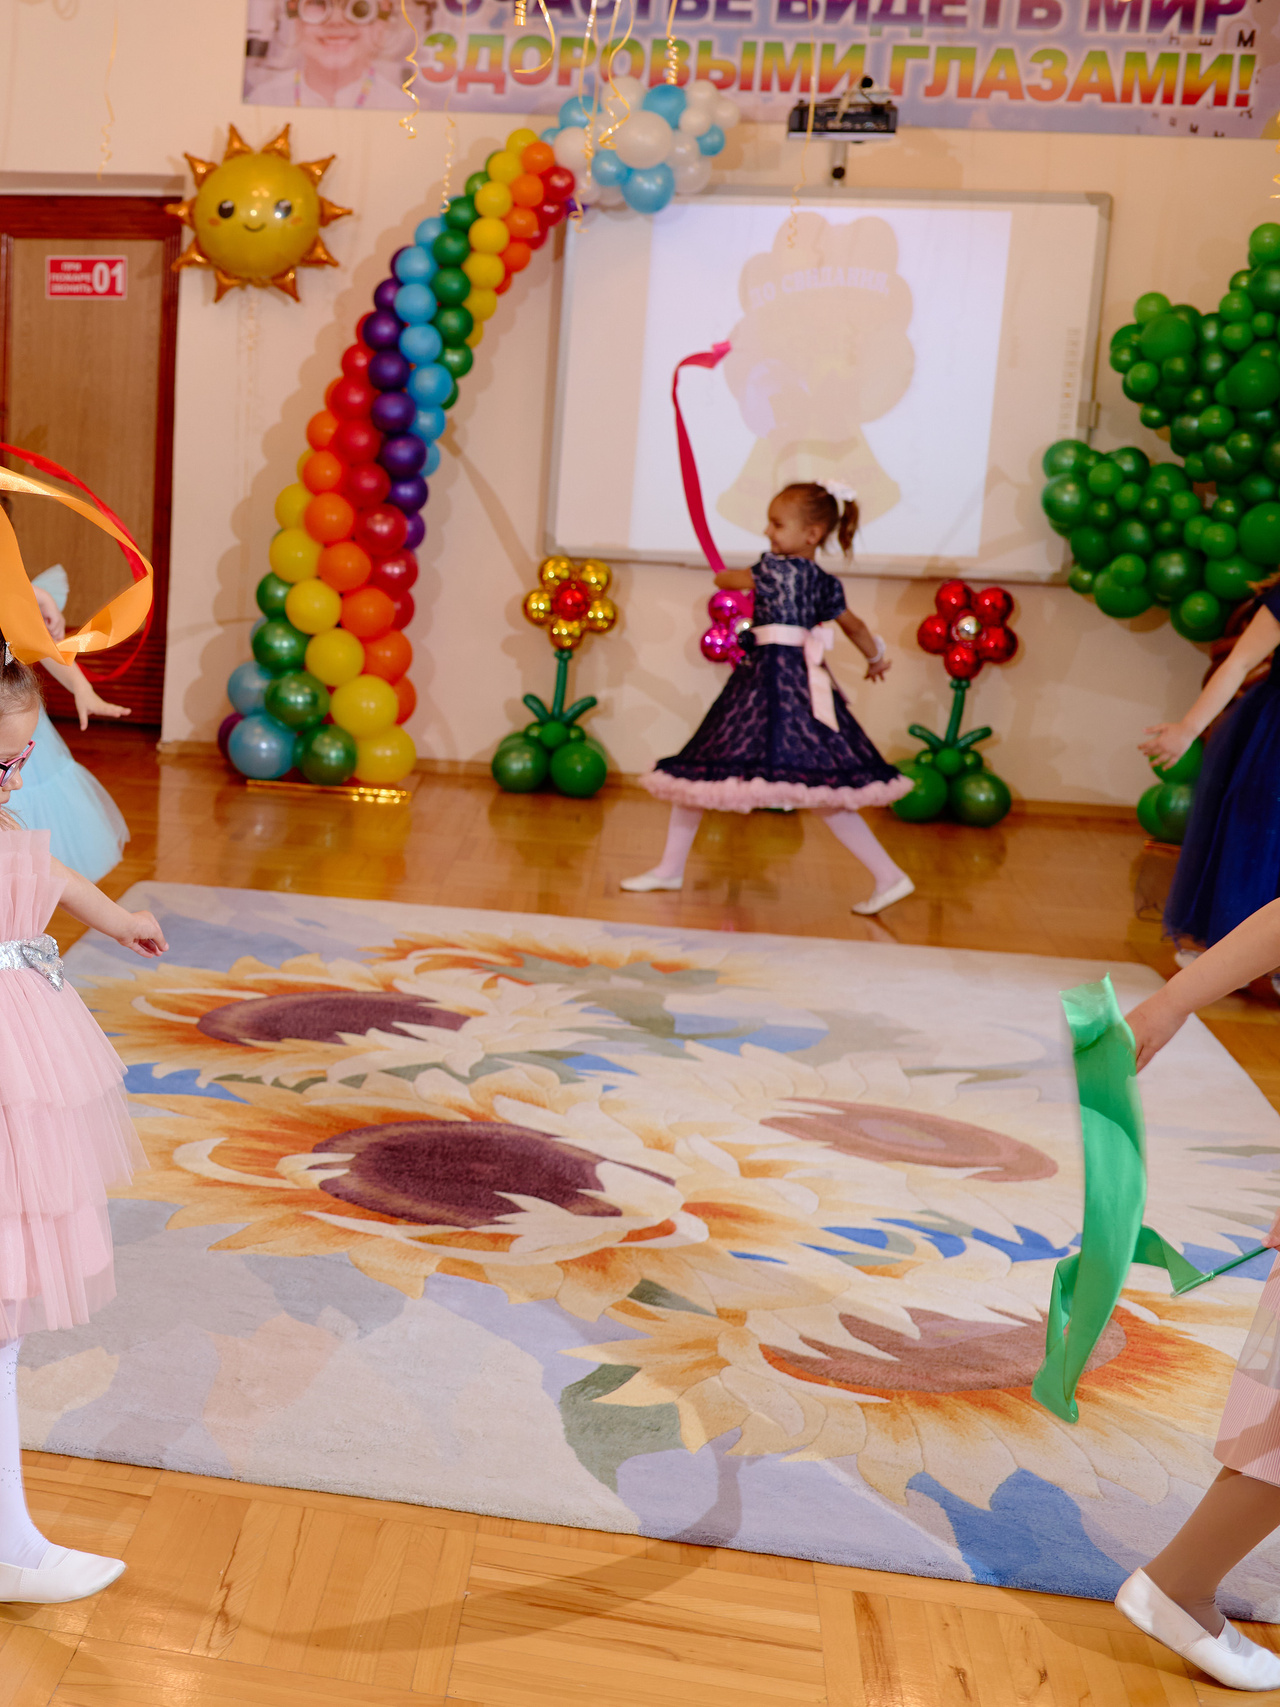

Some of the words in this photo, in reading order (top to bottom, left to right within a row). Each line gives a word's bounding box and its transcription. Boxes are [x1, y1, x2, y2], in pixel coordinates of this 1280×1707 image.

[421, 33, 866, 95] ЗДОРОВЫМИ
[890, 45, 1256, 107] ГЛАЗАМИ!
[92, 262, 124, 293] 01
